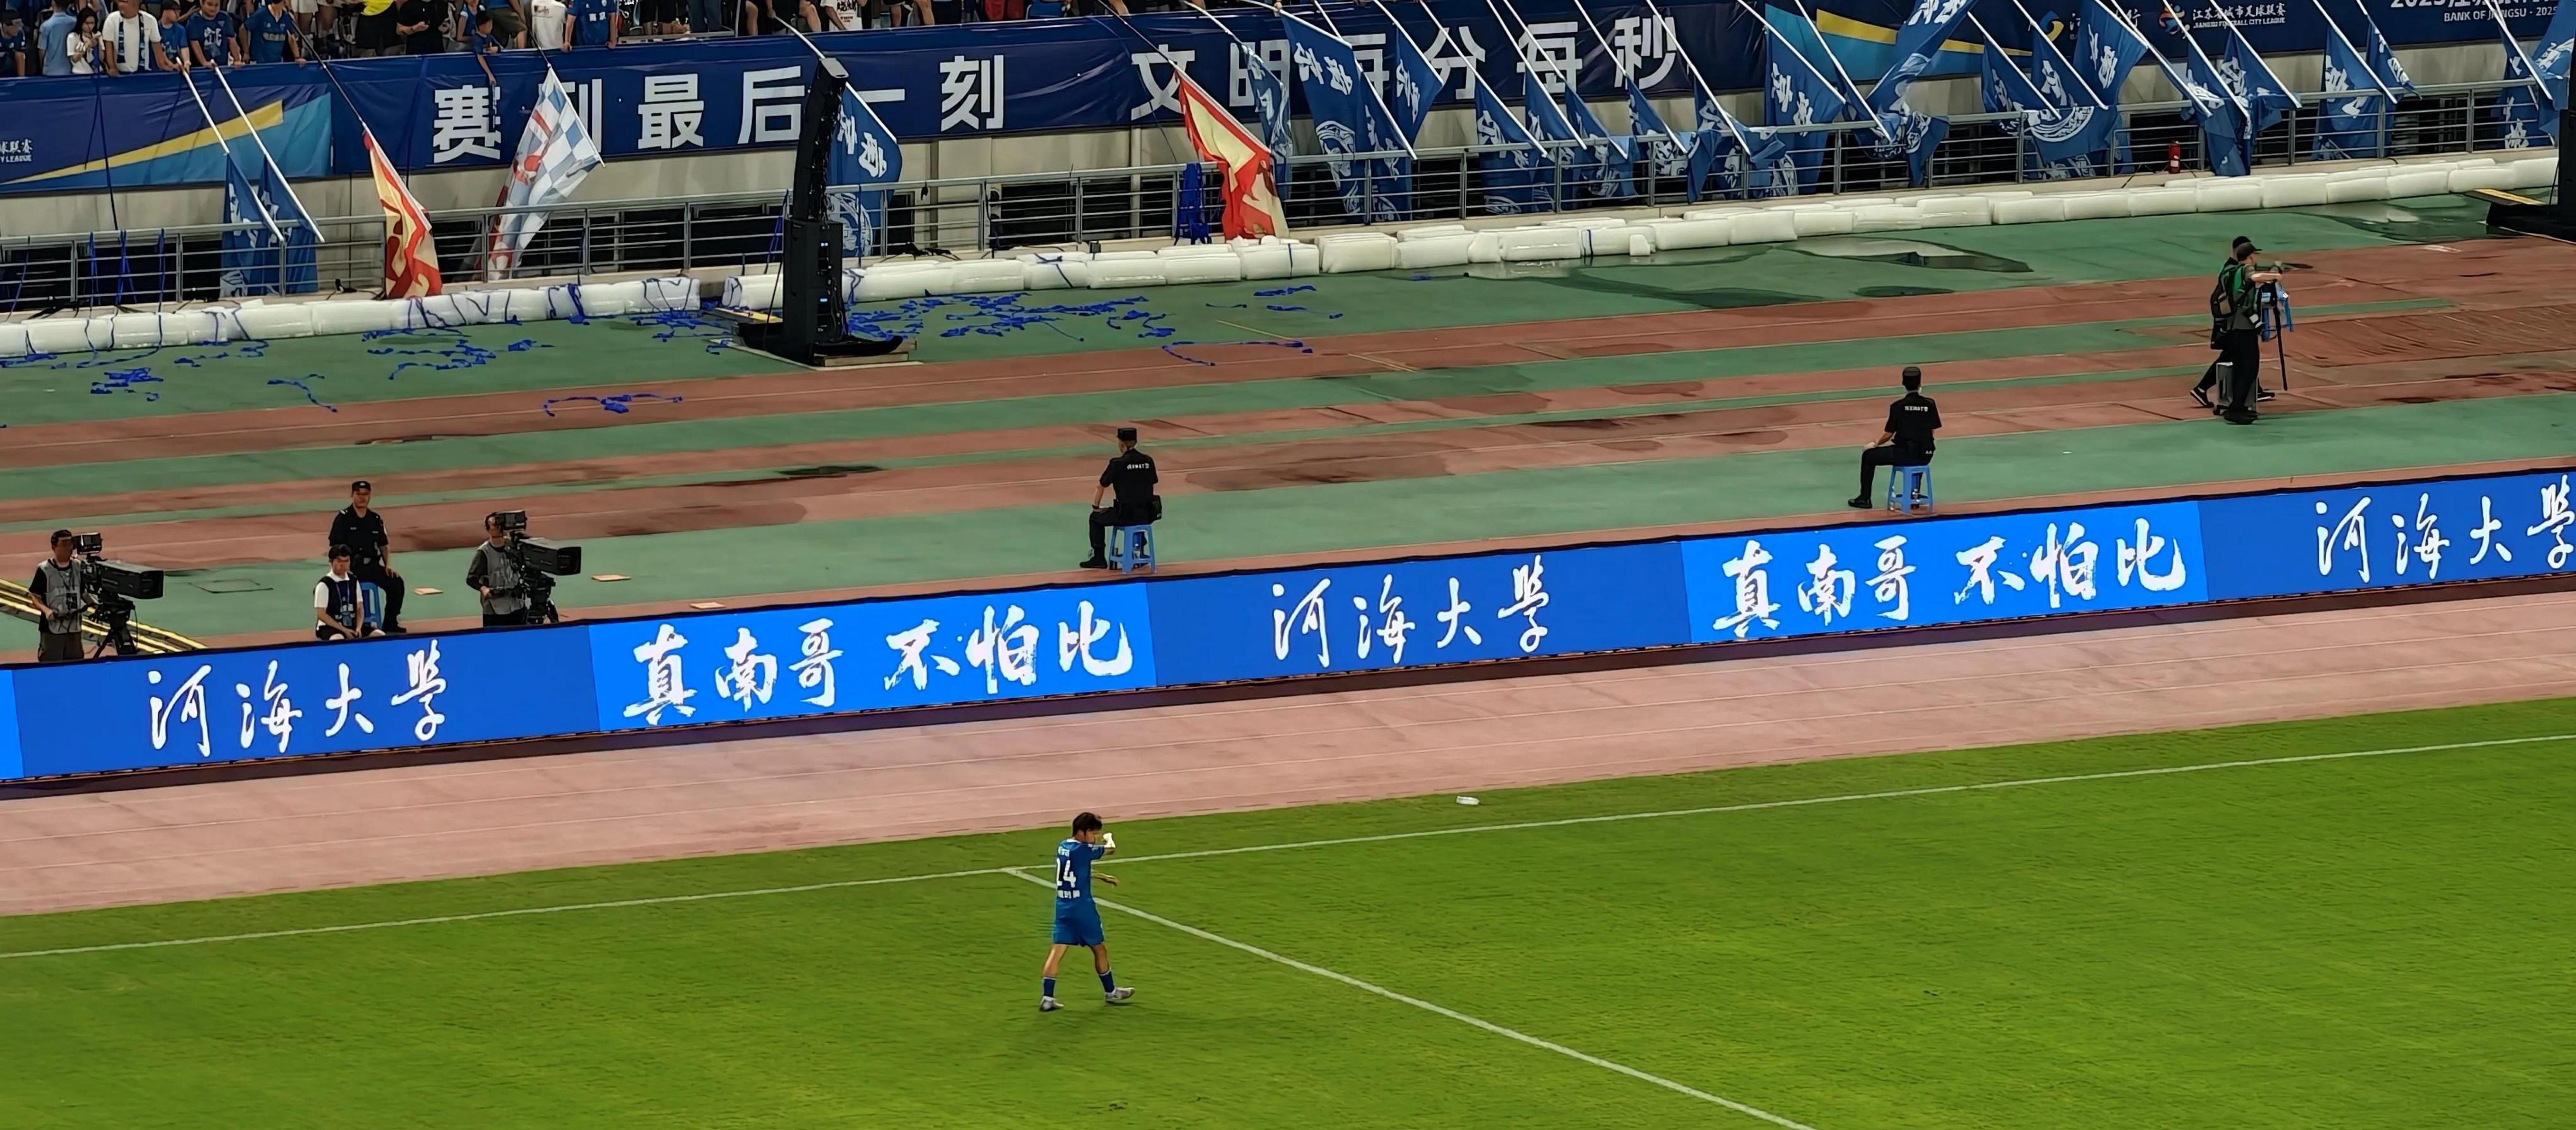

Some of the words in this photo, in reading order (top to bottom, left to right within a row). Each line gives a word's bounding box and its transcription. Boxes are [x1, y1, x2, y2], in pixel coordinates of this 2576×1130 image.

[2444, 12, 2471, 22] BANK
[2473, 10, 2486, 20] OF
[2487, 8, 2527, 20] JINGSU
[1713, 536, 1916, 638] 真南哥
[1954, 518, 2186, 608] 不怕比
[623, 617, 844, 726] 真南哥
[883, 600, 1133, 694] 不怕比
